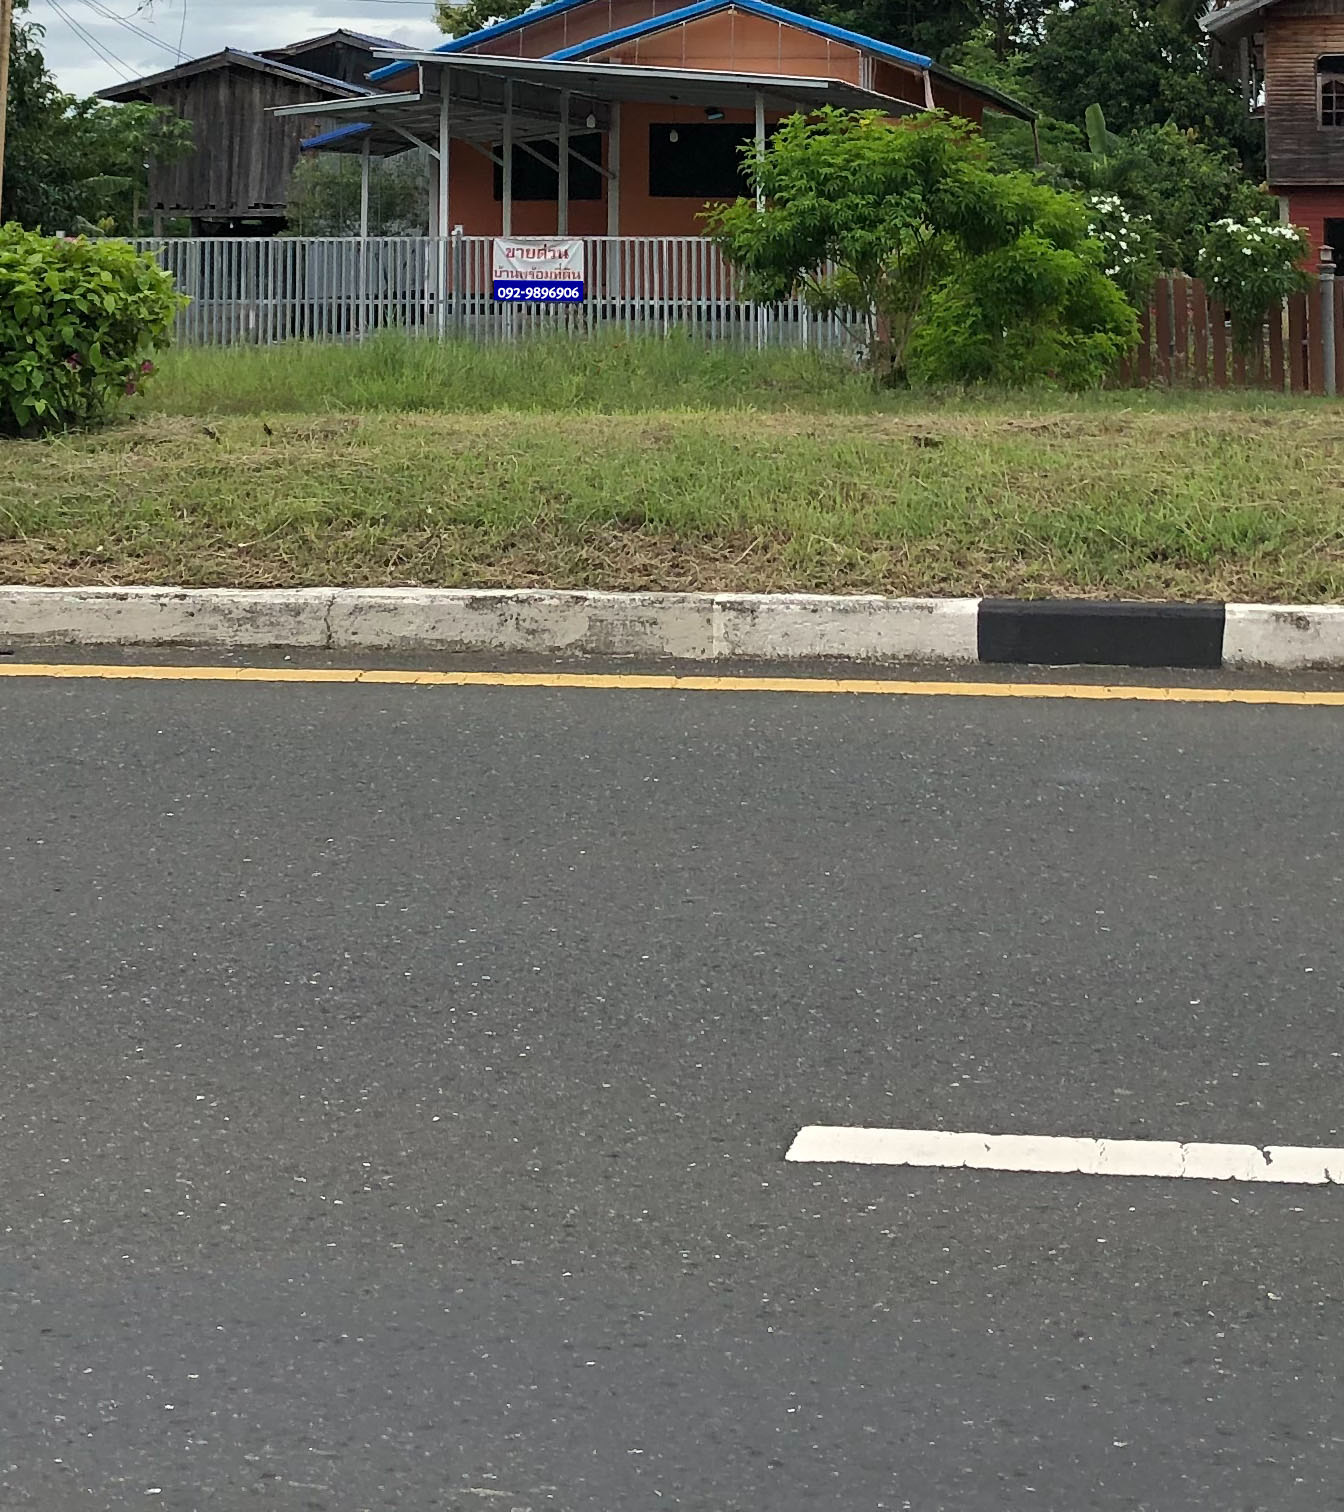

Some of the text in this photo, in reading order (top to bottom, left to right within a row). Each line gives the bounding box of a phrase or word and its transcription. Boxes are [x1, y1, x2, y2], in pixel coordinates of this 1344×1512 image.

[506, 244, 568, 259] ขายด่วน
[497, 287, 579, 299] 092-9896906
